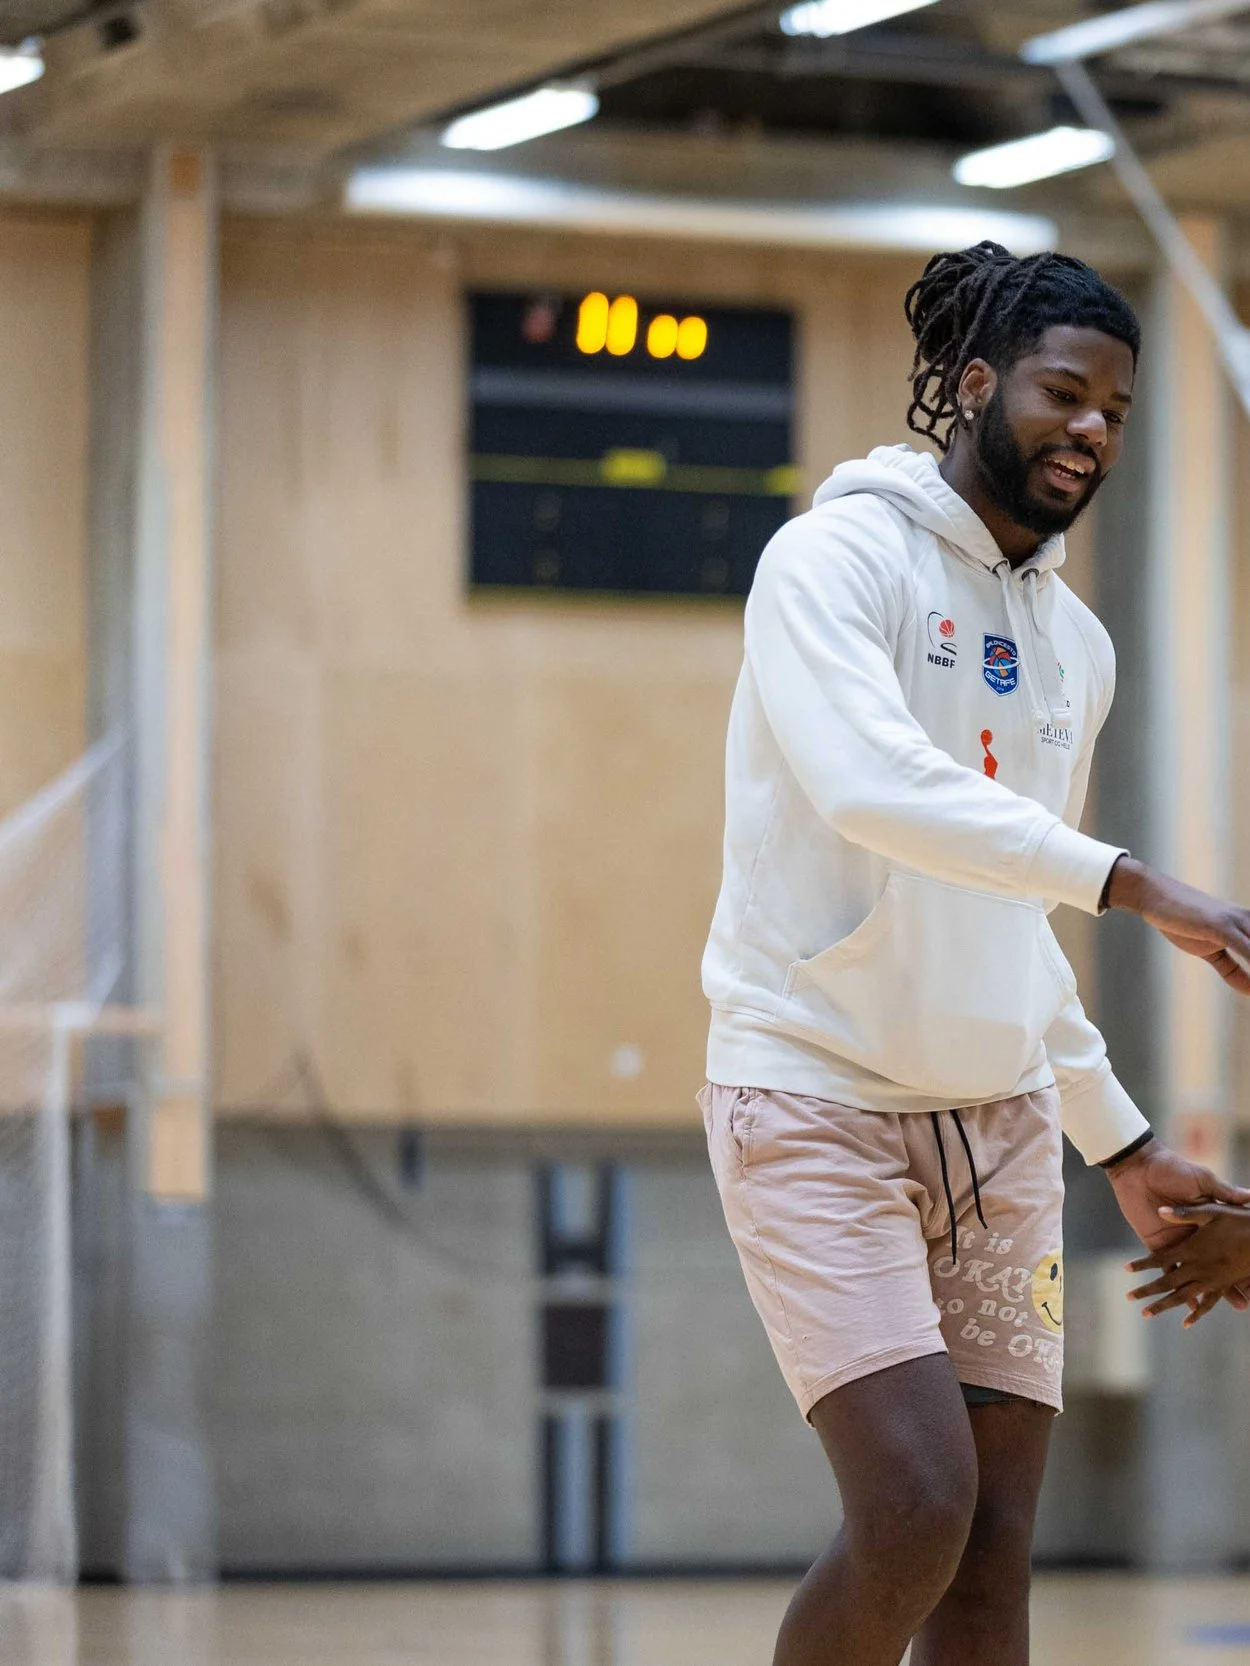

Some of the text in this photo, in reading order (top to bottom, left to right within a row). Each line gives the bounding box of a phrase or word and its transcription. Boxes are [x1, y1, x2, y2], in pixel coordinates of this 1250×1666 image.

[927, 652, 956, 669] NBBF
[985, 670, 1016, 686] GETAFE
[984, 1232, 1014, 1255] is
[933, 1256, 1033, 1303] OKAY
[977, 1299, 1029, 1328] not
[960, 1318, 996, 1347] be
